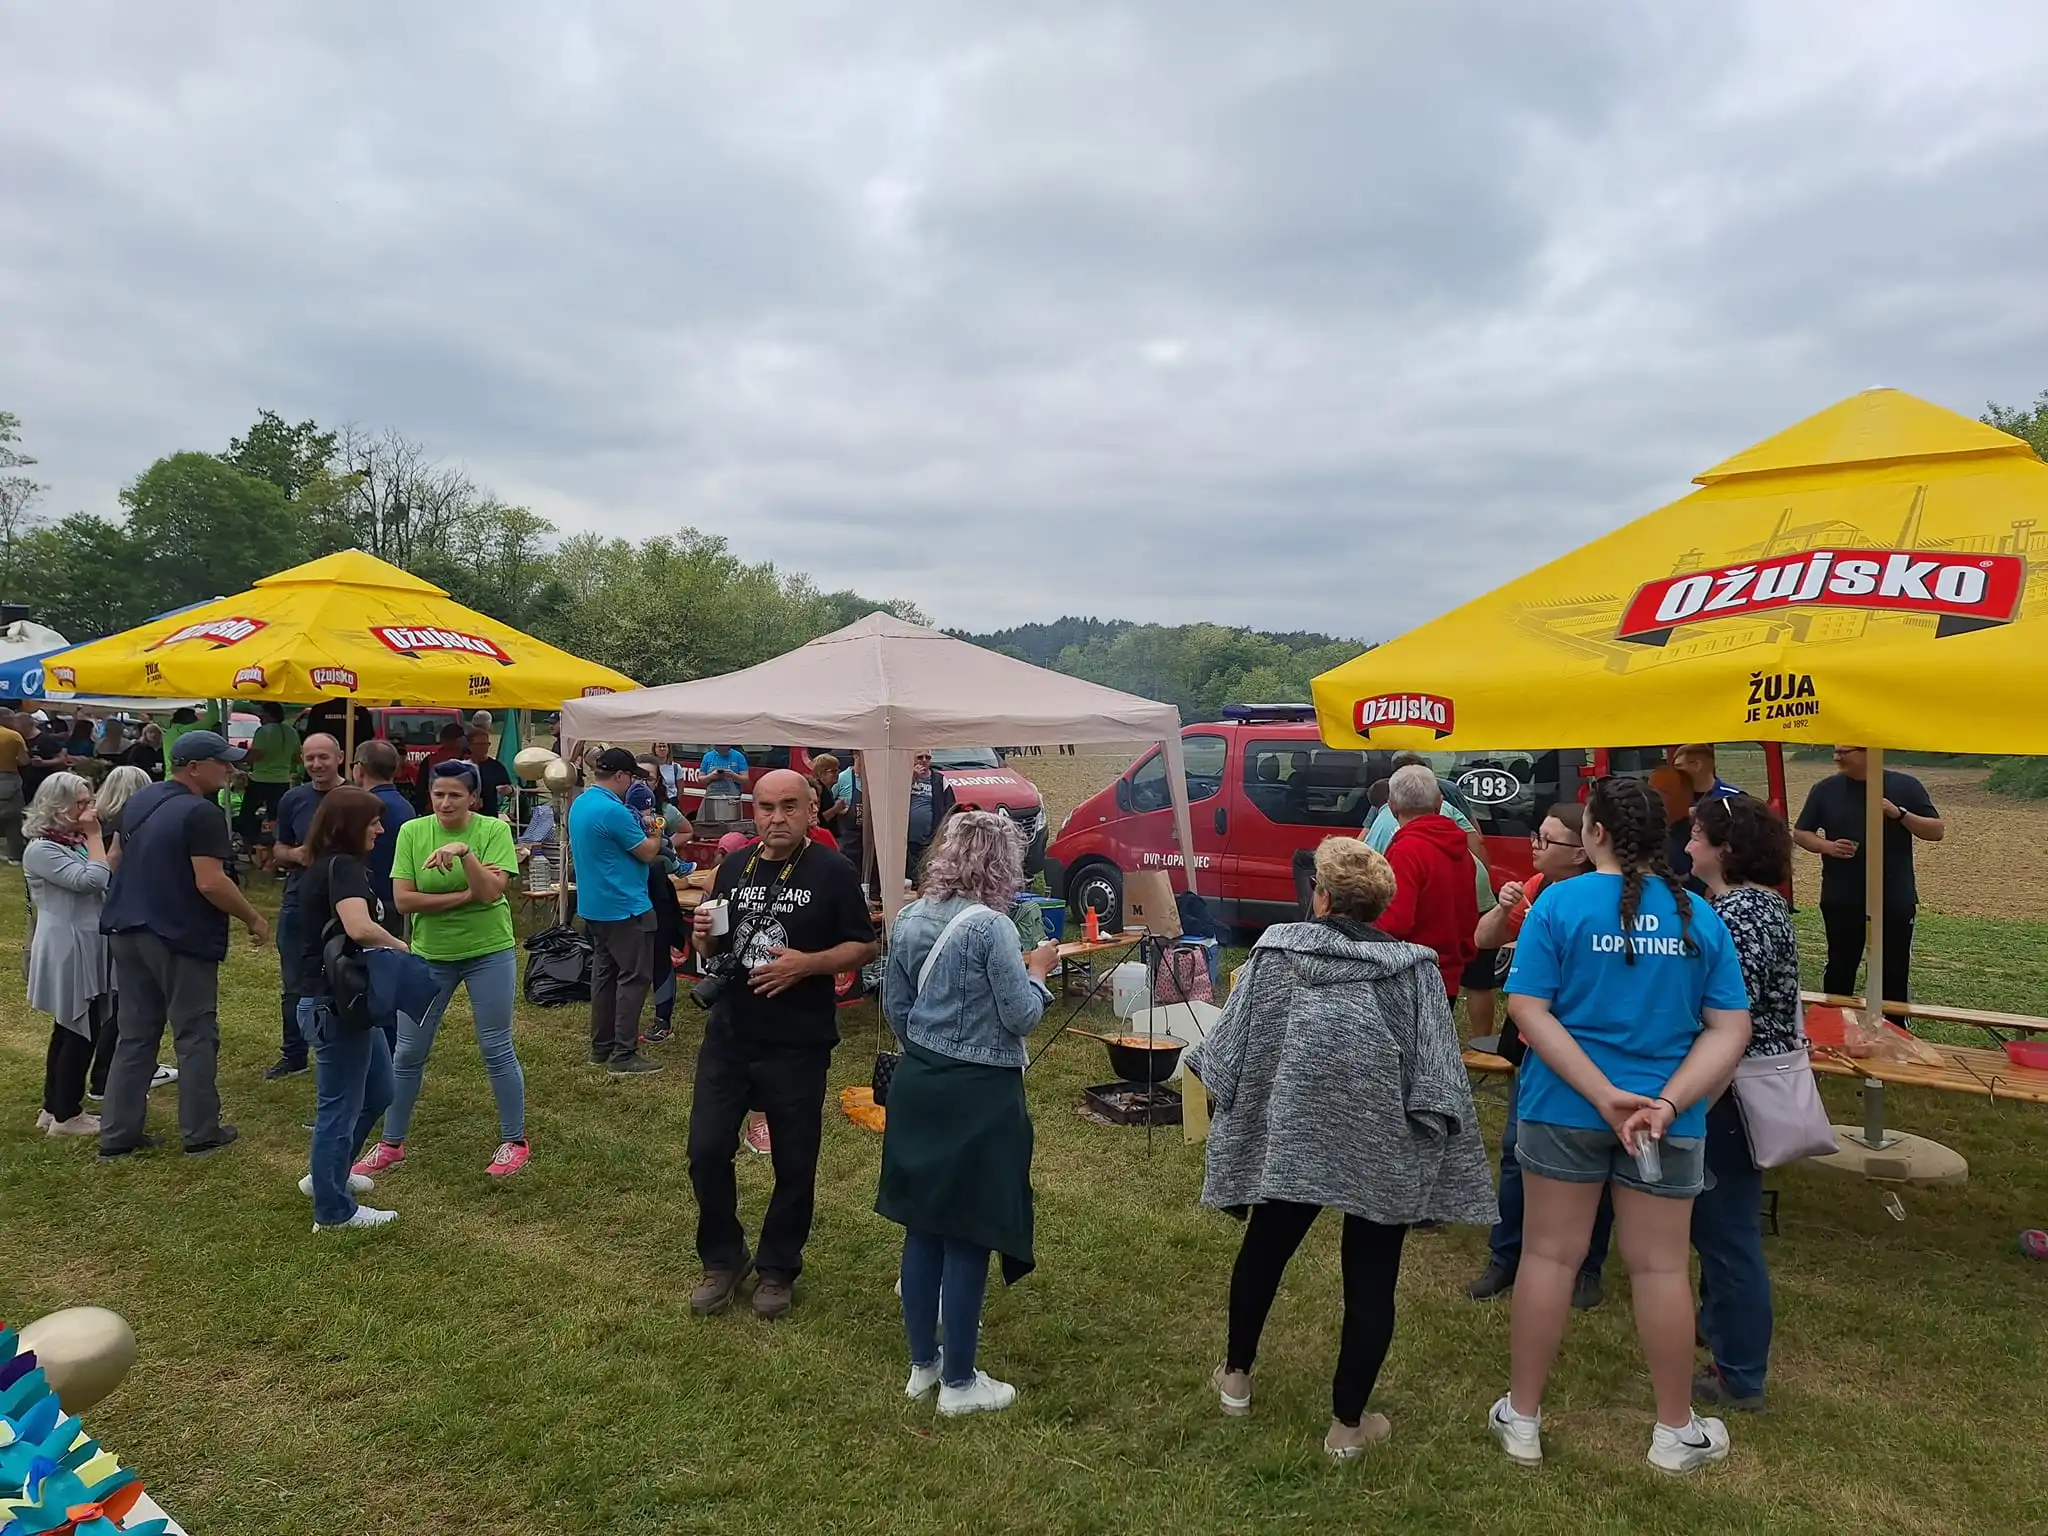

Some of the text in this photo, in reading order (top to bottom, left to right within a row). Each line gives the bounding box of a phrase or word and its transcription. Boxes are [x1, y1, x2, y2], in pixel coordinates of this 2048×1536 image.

[1655, 552, 1985, 622] Ožujsko
[469, 674, 490, 688] ŽUJA
[1747, 671, 1816, 705] ŽUJA
[1362, 695, 1446, 725] Ožujsko
[1744, 700, 1820, 723] JE ZAKON!
[1470, 776, 1507, 797] 193
[1162, 854, 1210, 869] LOPANEC
